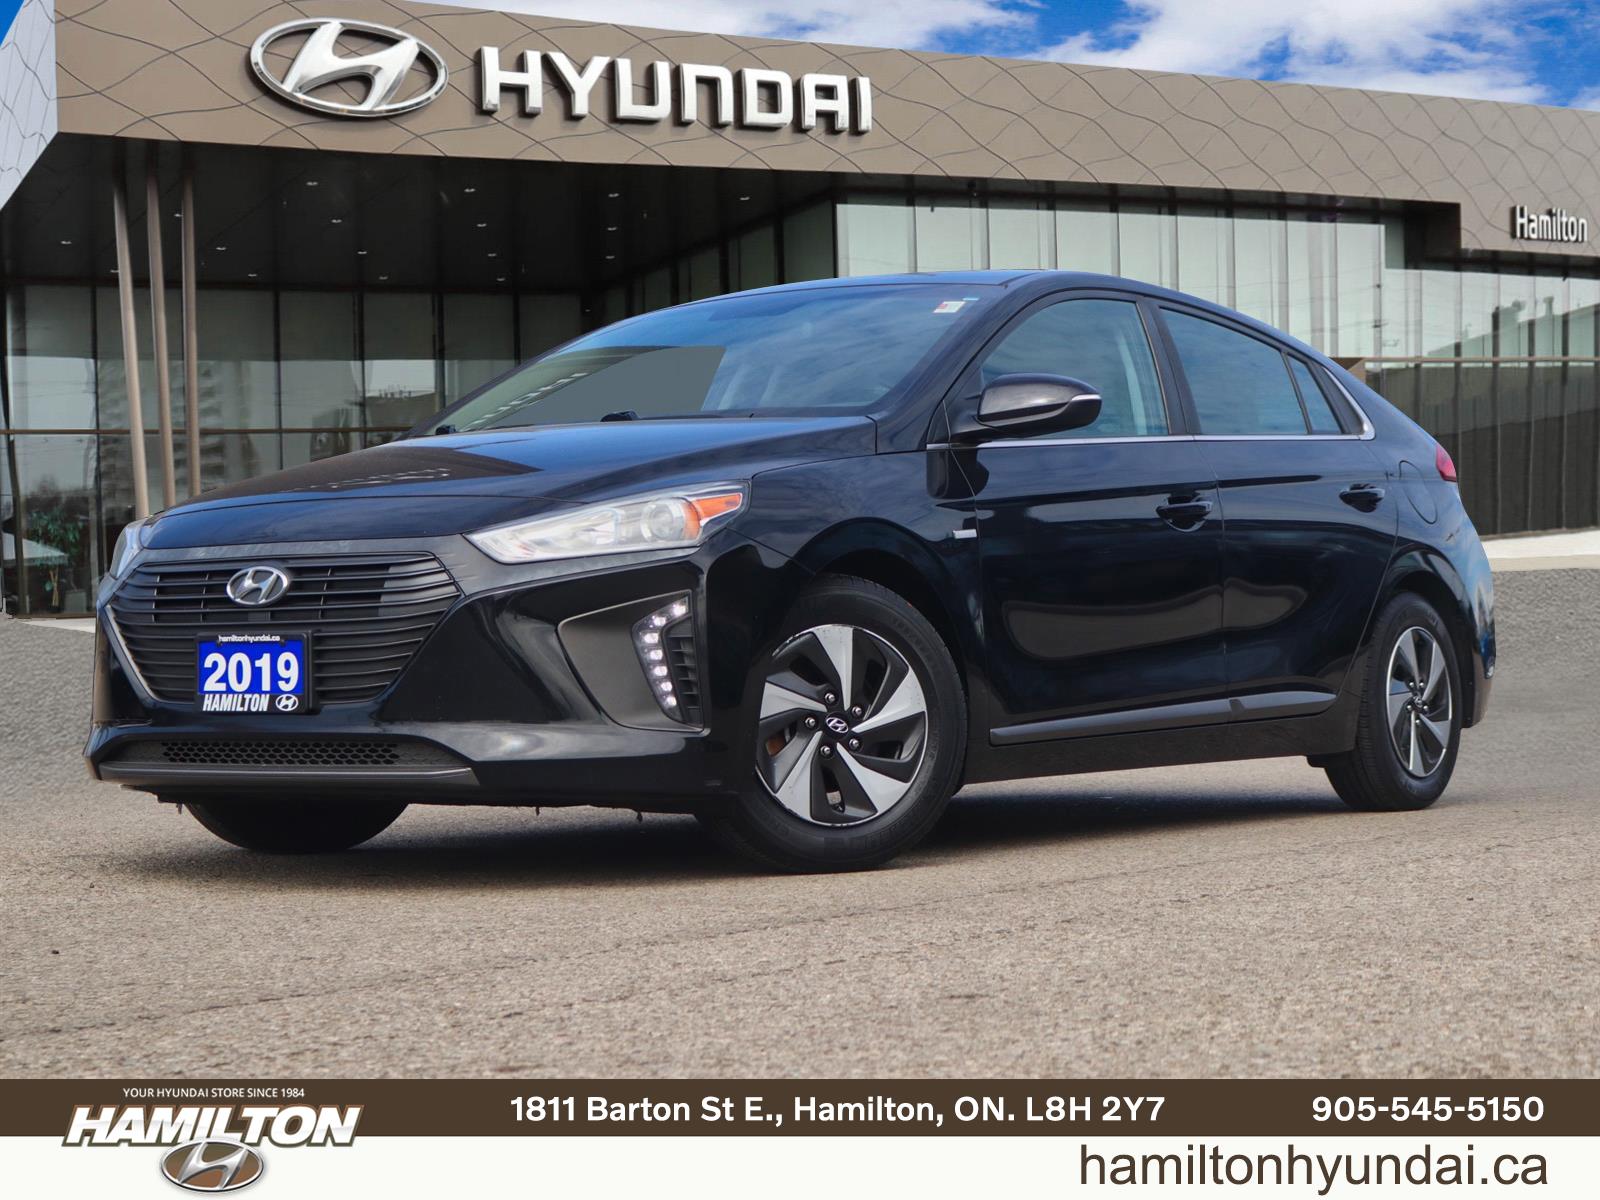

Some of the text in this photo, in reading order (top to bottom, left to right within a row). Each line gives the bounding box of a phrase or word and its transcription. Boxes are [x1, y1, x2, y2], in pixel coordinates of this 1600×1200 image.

[478, 46, 873, 133] HYUNDAI
[1514, 204, 1588, 242] Hamilton
[203, 652, 299, 692] 2019
[202, 693, 270, 712] HAMILTON
